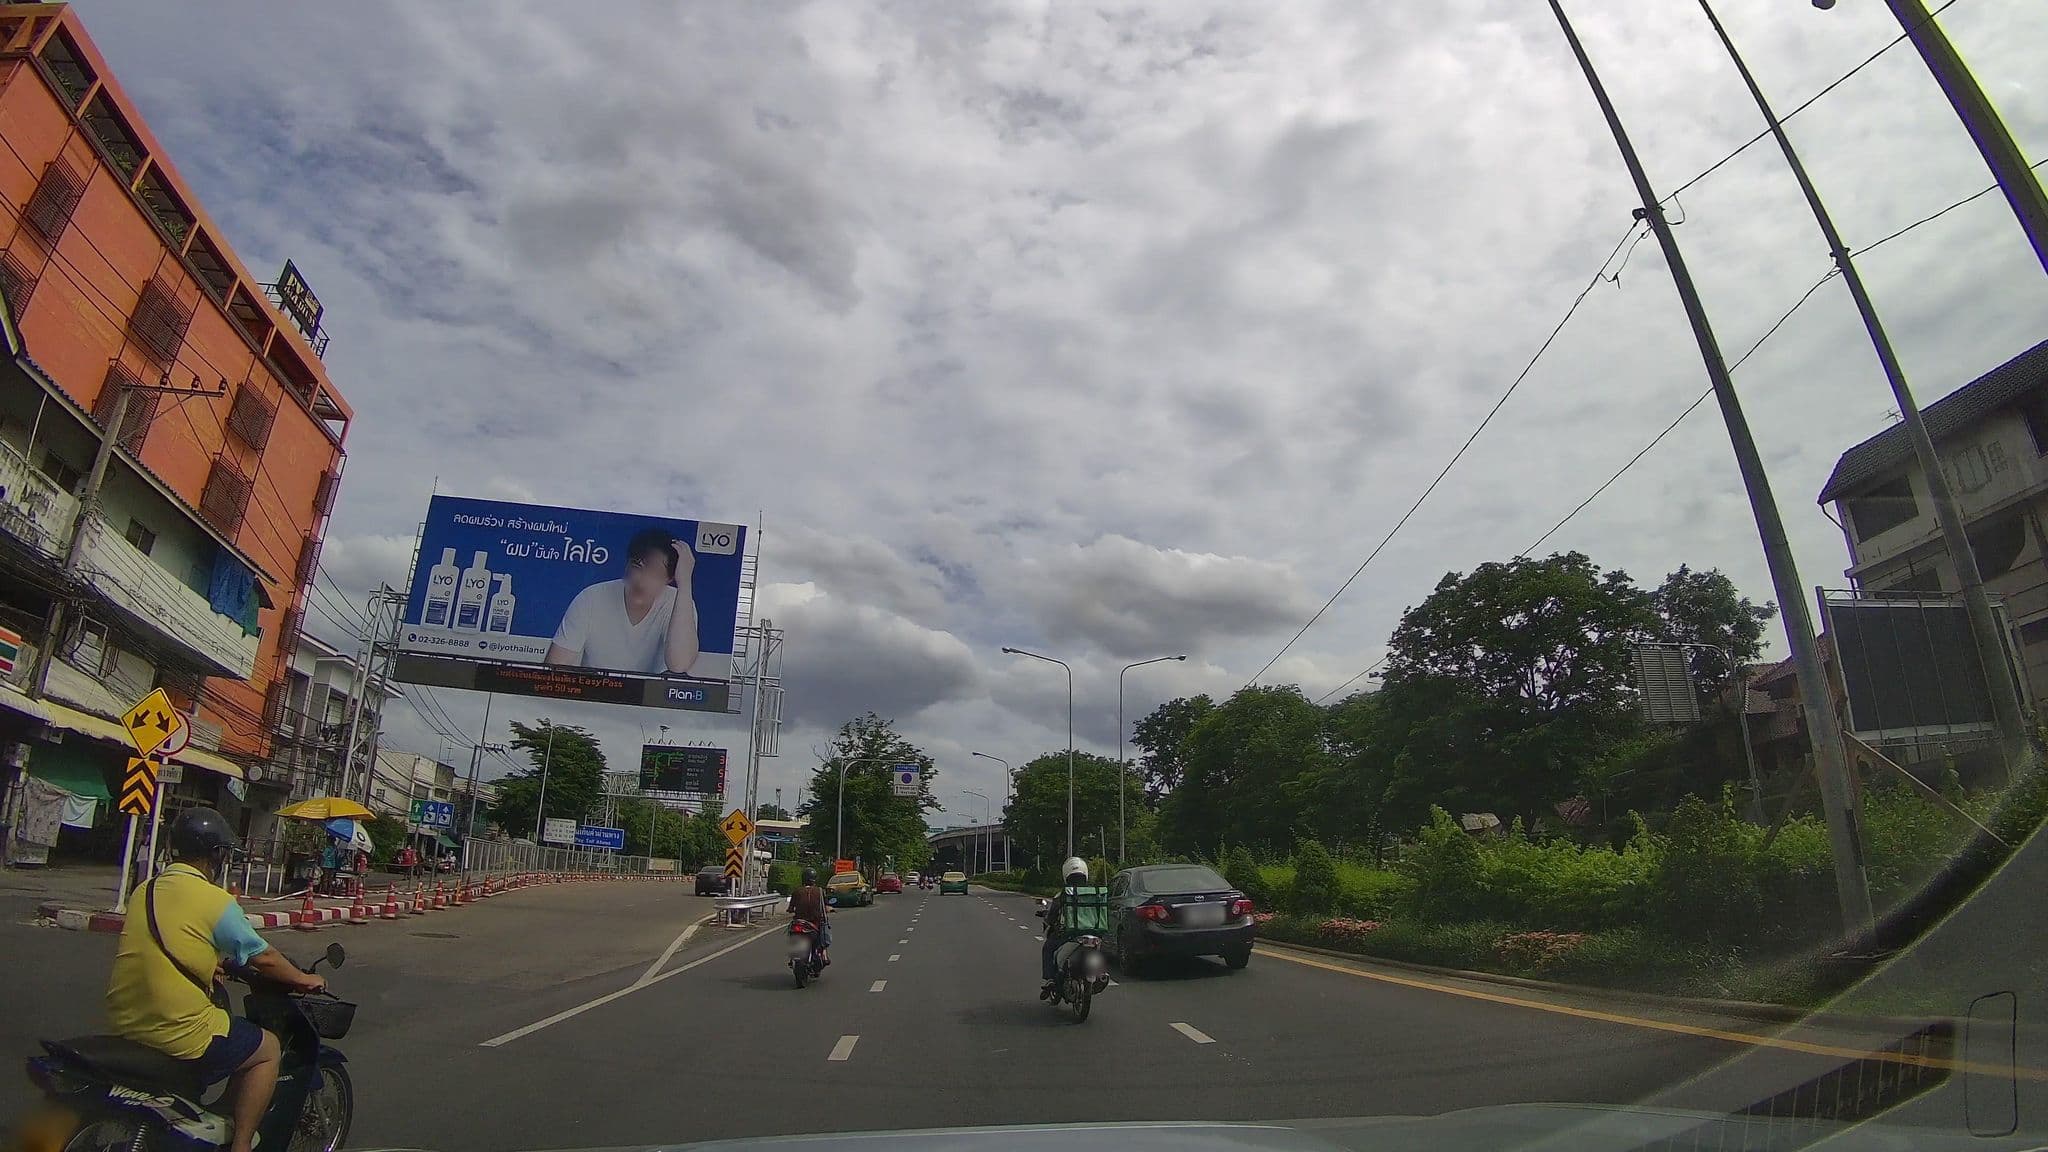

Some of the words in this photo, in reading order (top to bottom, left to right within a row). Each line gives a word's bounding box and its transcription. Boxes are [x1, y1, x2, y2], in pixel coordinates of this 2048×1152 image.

[453, 513, 504, 528] ลดผมร่วง
[507, 517, 569, 534] สร้างผมใหม่
[702, 533, 730, 547] LYO
[563, 537, 609, 564] ไลโอ
[433, 575, 453, 585] LYO
[465, 578, 485, 589] LYO
[418, 635, 470, 648] 02-326-8888
[488, 642, 546, 654] @lyothailand
